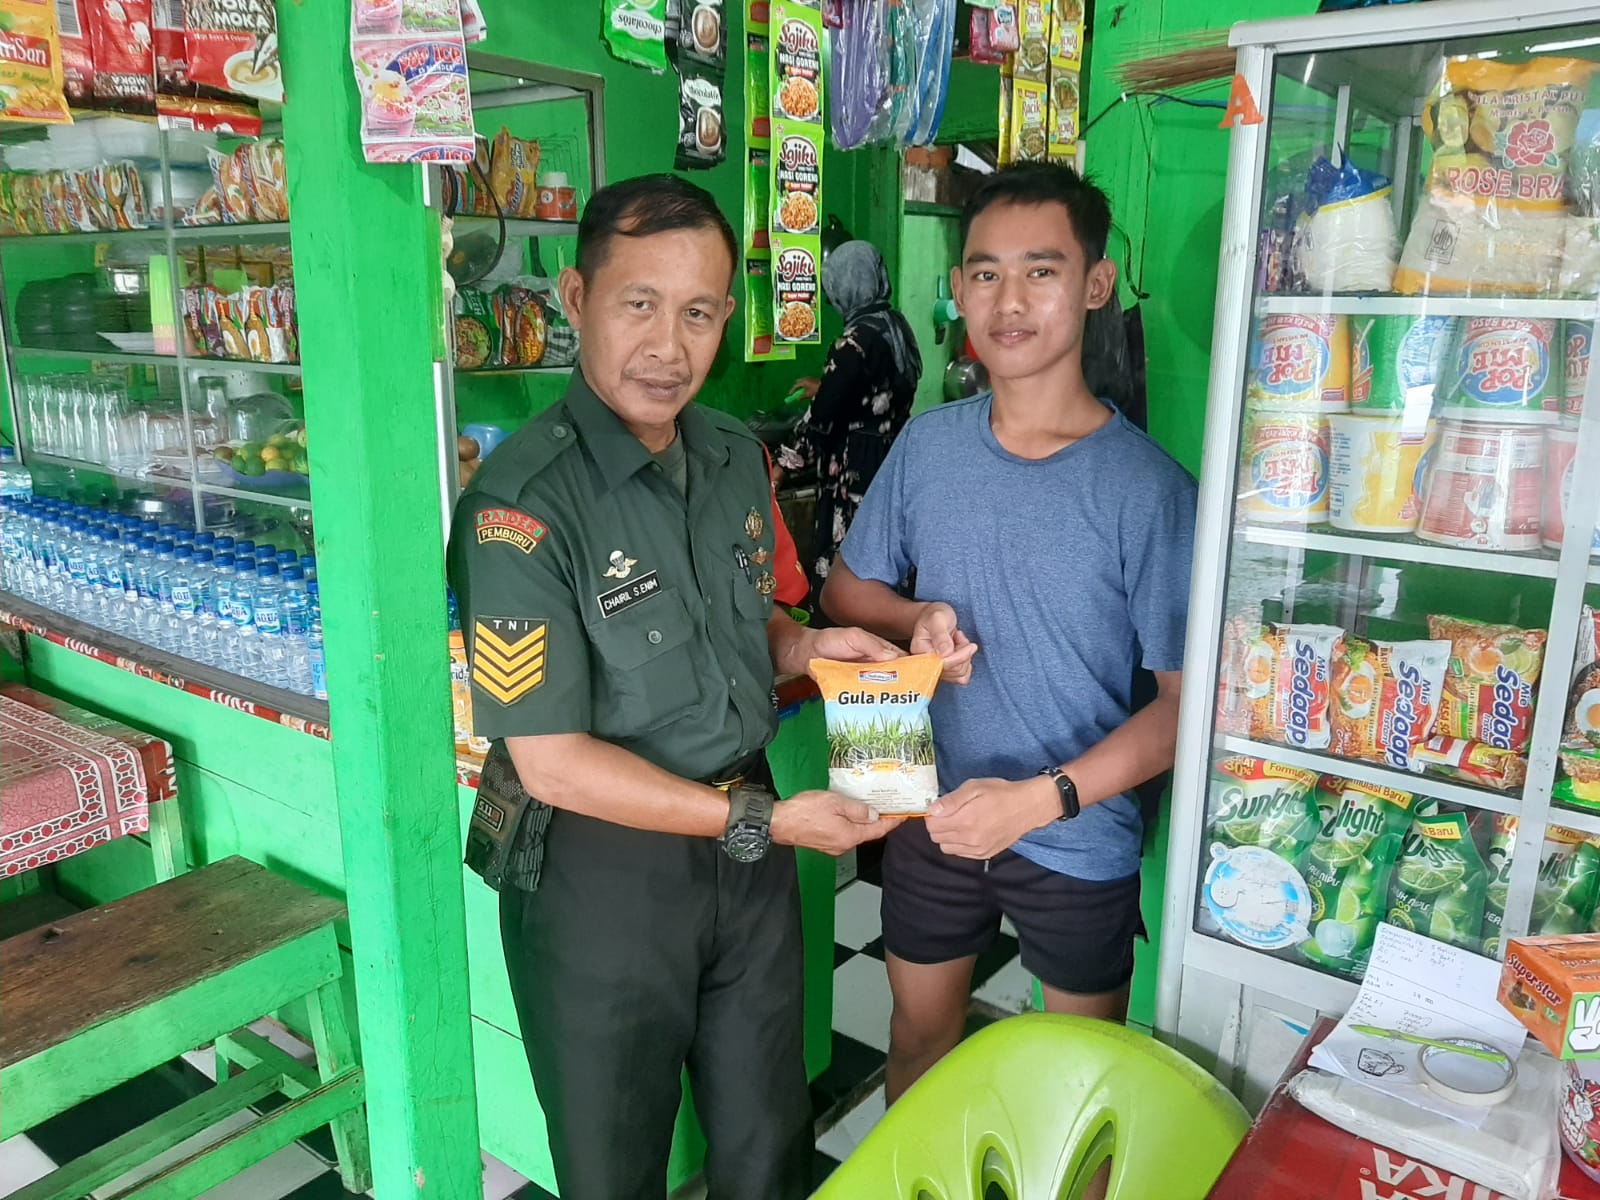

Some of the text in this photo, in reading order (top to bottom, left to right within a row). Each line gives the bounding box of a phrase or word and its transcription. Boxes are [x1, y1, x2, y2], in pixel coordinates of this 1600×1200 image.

[214, 12, 270, 29] MOKA
[779, 23, 818, 54] Sajiku
[1219, 74, 1265, 129] A
[779, 141, 817, 170] Sajiku
[1447, 166, 1513, 198] ROSE
[777, 253, 816, 281] Sajiku
[1472, 347, 1525, 374] MIE
[481, 527, 530, 548] PEMBURU
[256, 612, 279, 623] AQUA
[493, 619, 529, 632] TNI
[1317, 655, 1328, 682] Mie
[838, 690, 921, 705] Gula Pasir
[1286, 638, 1316, 745] Sedaap
[1421, 679, 1432, 706] Mie
[1520, 682, 1532, 707] Mie
[1382, 710, 1392, 745] Instant
[1387, 660, 1420, 768] Sedaap
[1383, 787, 1406, 804] Baru
[1428, 825, 1454, 837] Baru
[1507, 953, 1562, 1006] Superstar
